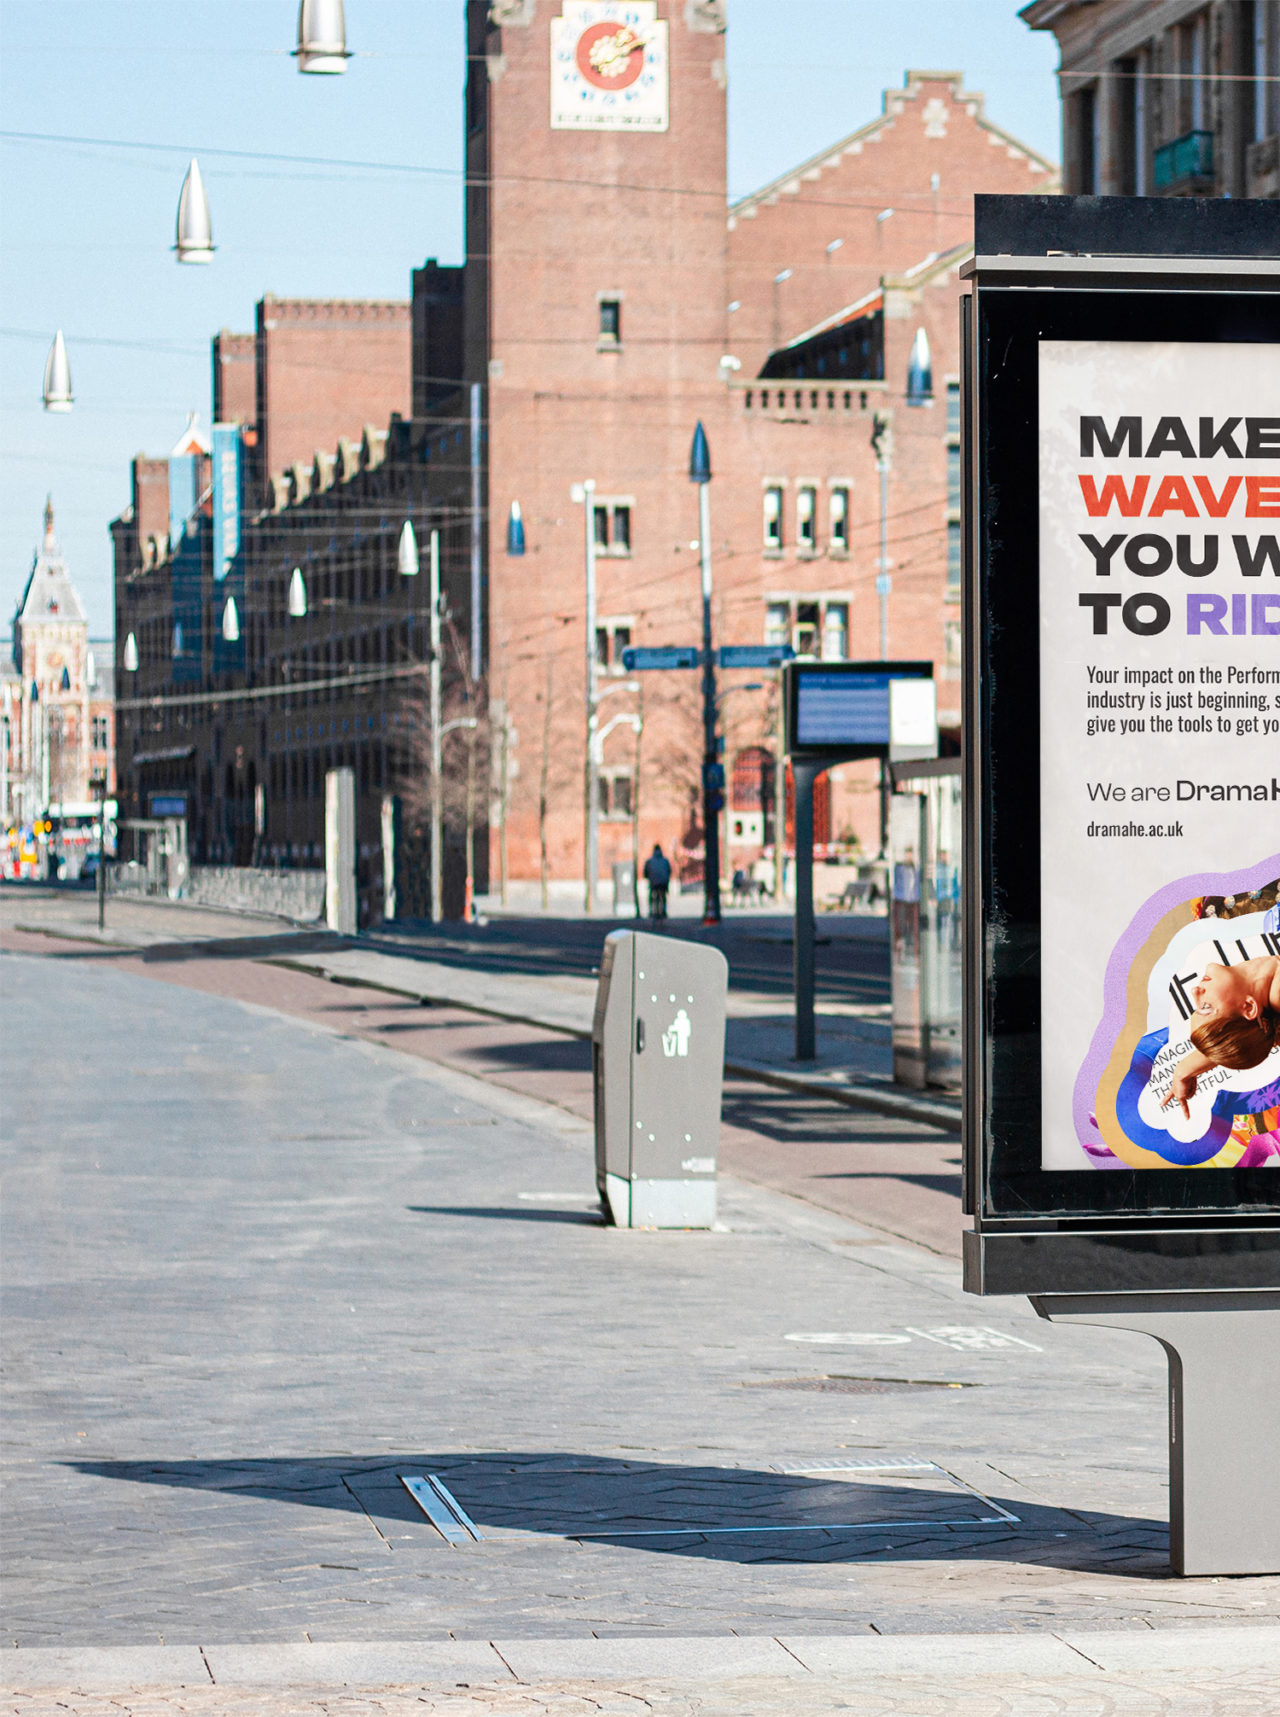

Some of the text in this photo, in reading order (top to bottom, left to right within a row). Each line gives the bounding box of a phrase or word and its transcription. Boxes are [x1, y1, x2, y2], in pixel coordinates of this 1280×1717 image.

[1078, 533, 1219, 577] YOU
[1079, 592, 1171, 636] TO
[1087, 666, 1119, 684] Your
[1124, 666, 1173, 688] impact
[1178, 671, 1195, 684] on
[1199, 666, 1222, 684] the
[1088, 690, 1145, 712] industry
[1150, 691, 1162, 709] is
[1165, 691, 1193, 712] just
[1198, 690, 1270, 712] beginning,
[1087, 715, 1115, 736] give
[1120, 719, 1145, 736] you
[1150, 715, 1173, 733] the
[1178, 715, 1213, 733] tools
[1217, 716, 1231, 733] to
[1236, 716, 1259, 736] get
[1087, 783, 1126, 801] We
[1131, 786, 1170, 801] are
[1087, 821, 1183, 837] dramahe.ac.uk
